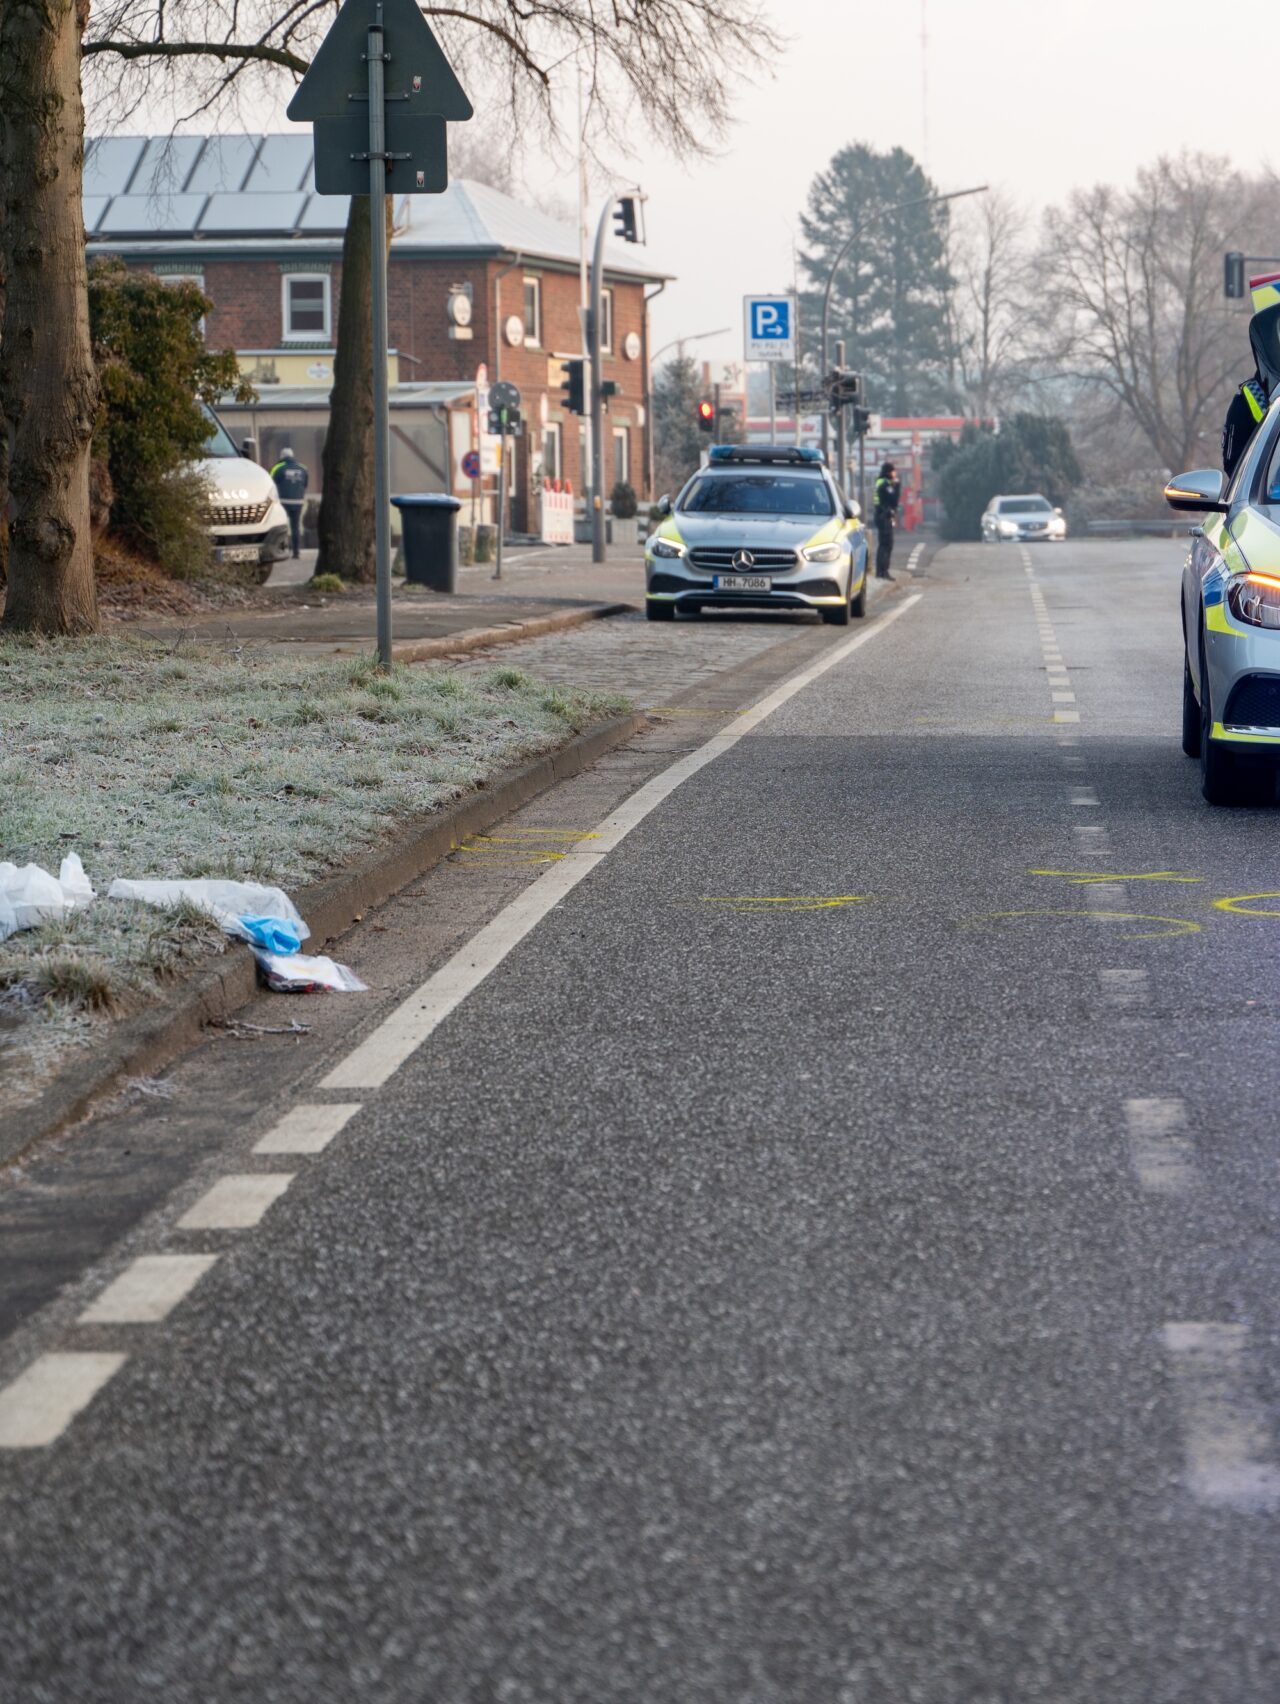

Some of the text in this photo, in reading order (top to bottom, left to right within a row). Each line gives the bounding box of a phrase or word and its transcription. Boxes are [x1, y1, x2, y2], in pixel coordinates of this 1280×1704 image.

[756, 305, 778, 336] P
[723, 577, 766, 587] HH 7086
